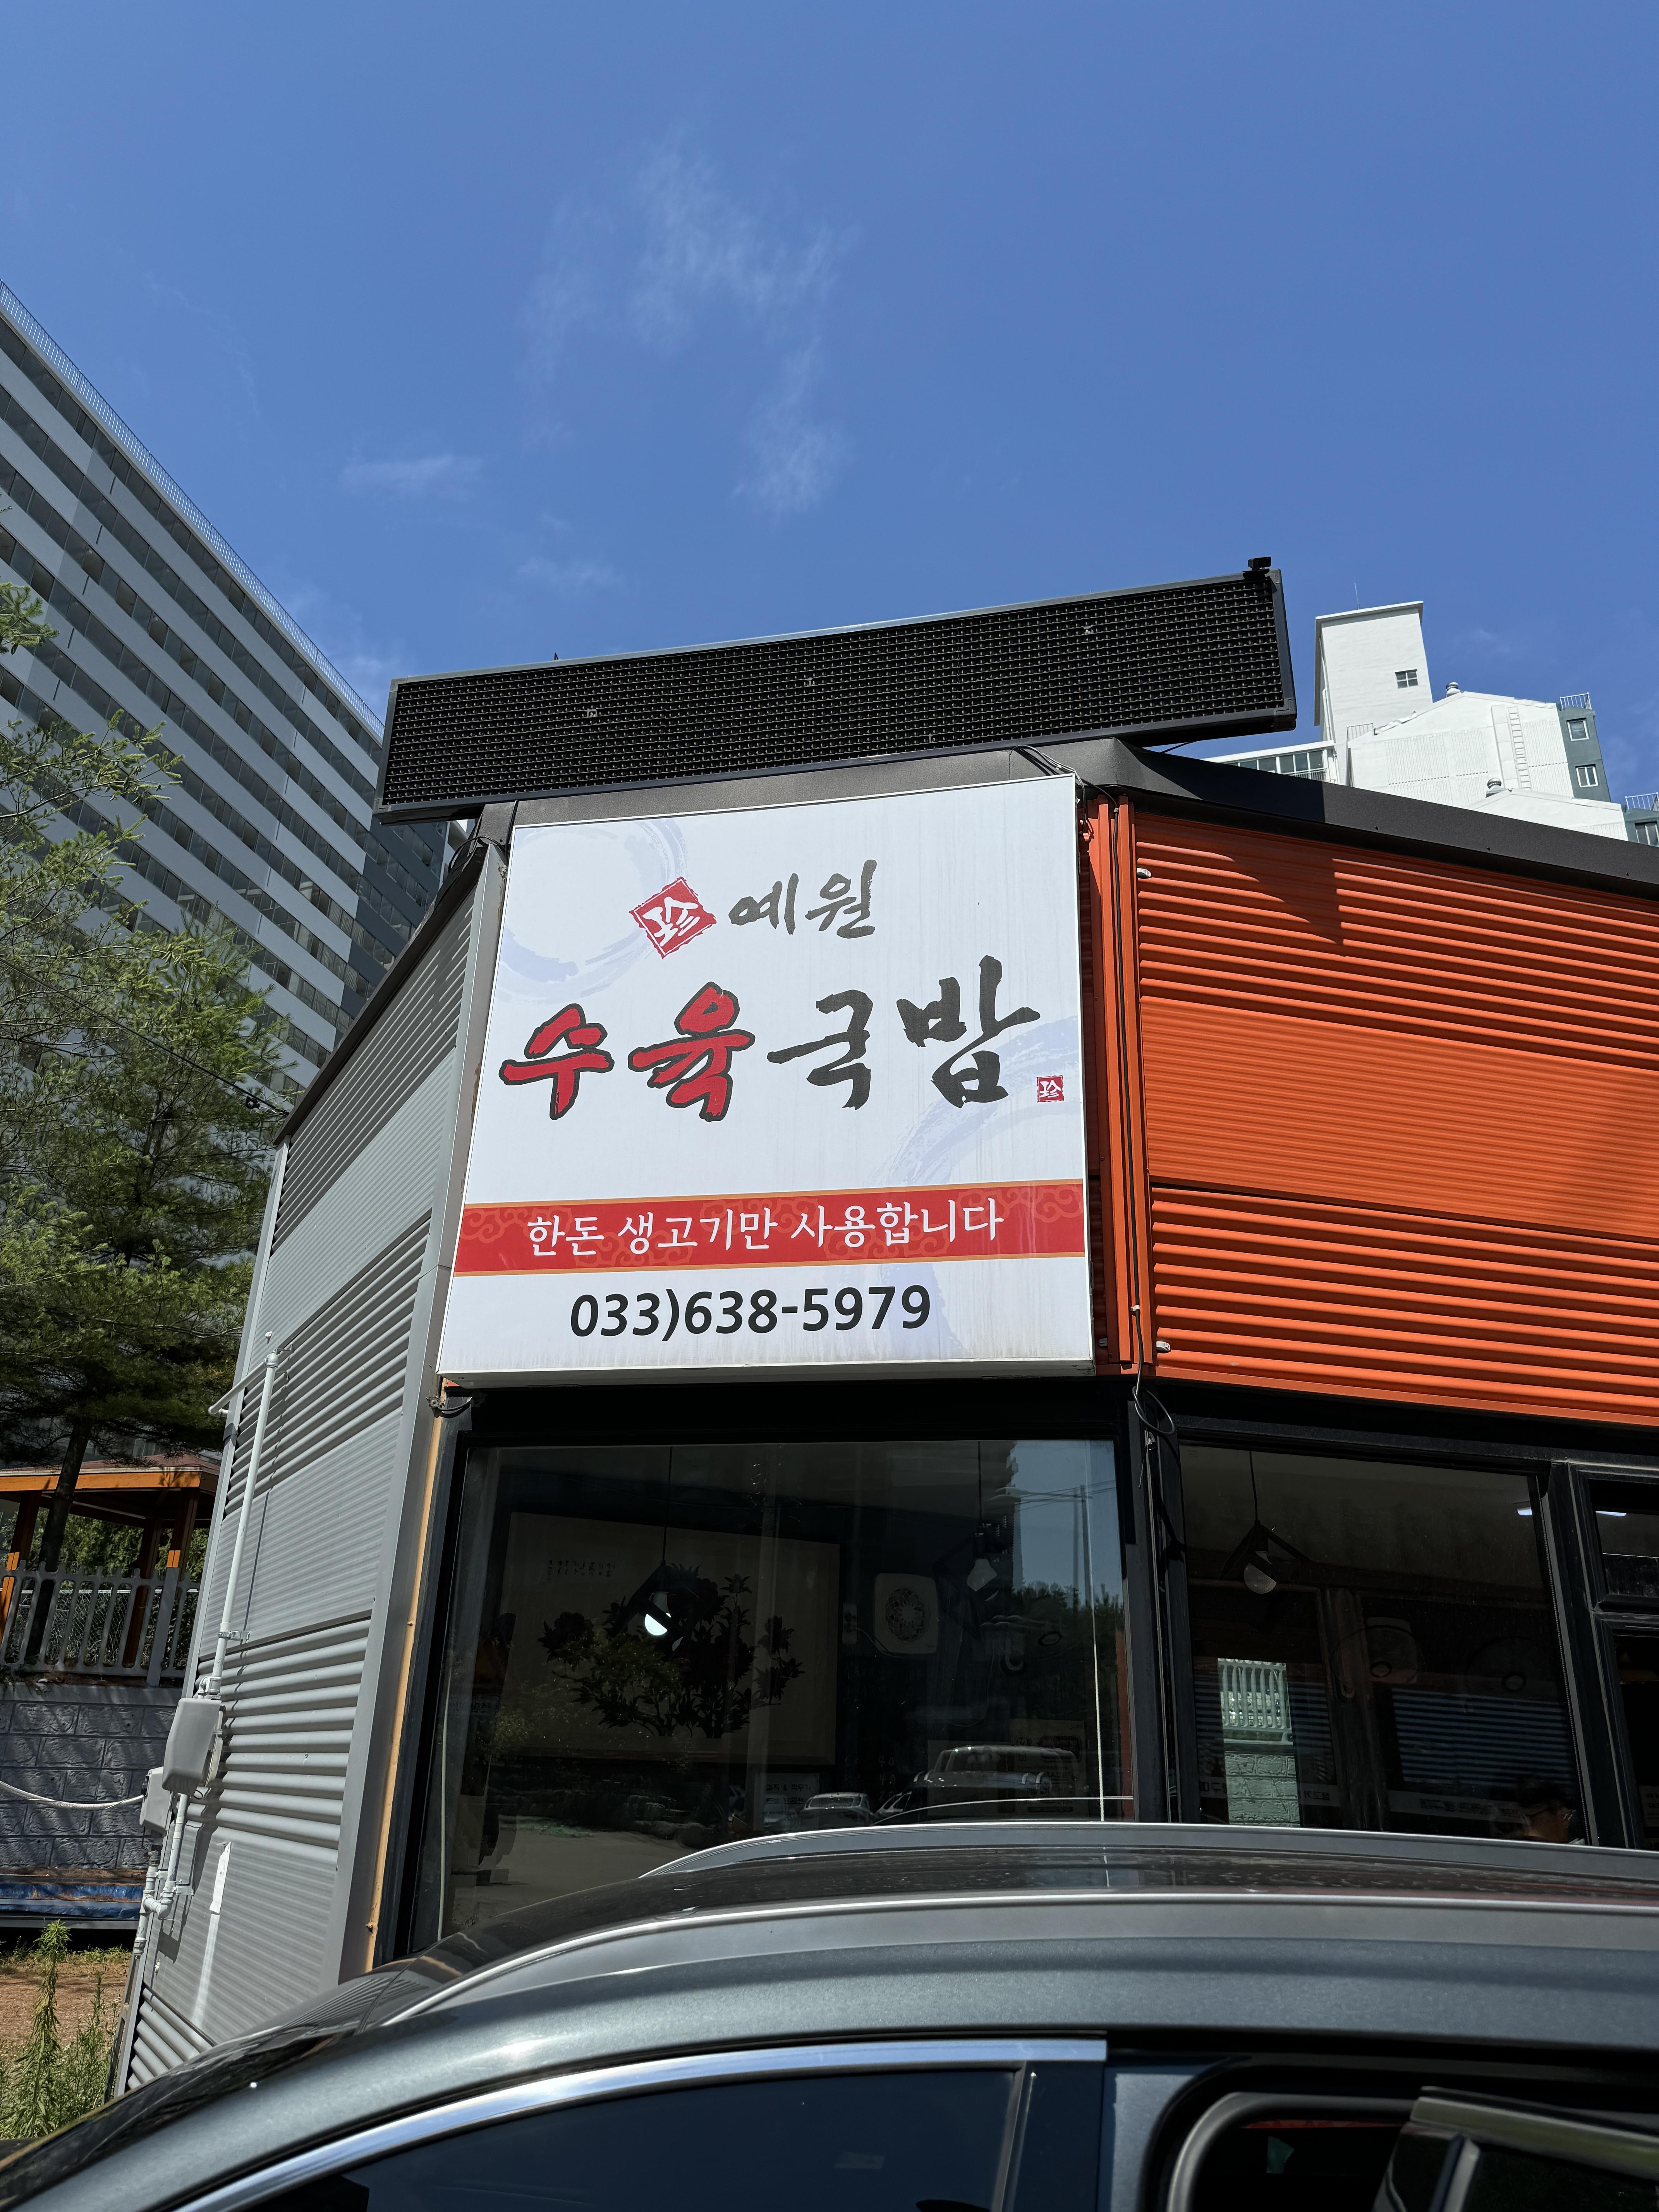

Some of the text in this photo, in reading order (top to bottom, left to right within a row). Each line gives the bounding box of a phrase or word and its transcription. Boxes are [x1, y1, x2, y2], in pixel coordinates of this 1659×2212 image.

[728, 859, 878, 939] 예원
[527, 1197, 1005, 1256] 한돈 생고기만 사용합니다
[571, 1285, 930, 1341] 033)638-5979
